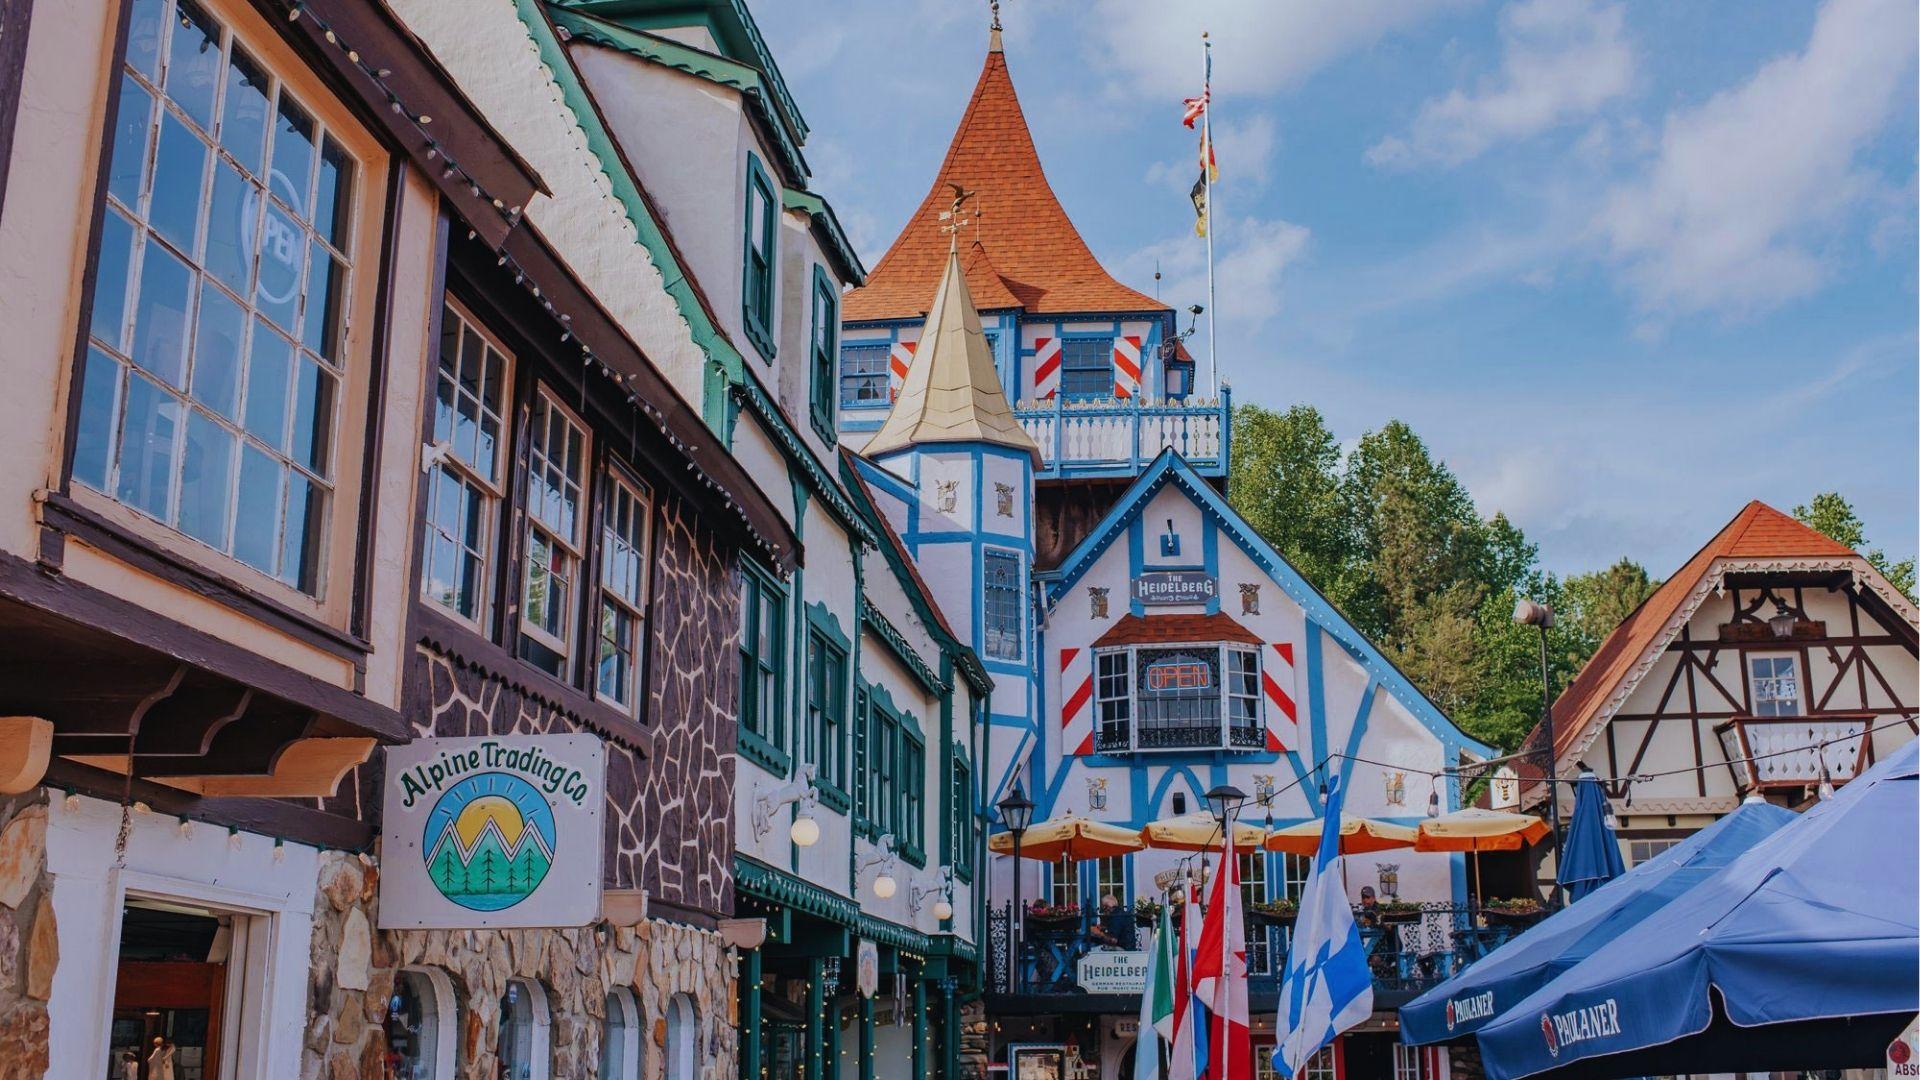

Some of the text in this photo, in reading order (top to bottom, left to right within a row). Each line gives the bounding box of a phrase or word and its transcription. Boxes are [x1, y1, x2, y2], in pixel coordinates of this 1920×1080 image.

[1138, 579, 1213, 597] HEIDELBERG
[1149, 664, 1207, 689] OPEN
[400, 742, 588, 808] Alpine Trading Co.
[1113, 955, 1129, 964] THE
[1083, 964, 1148, 981] HEIDELBER
[1453, 990, 1494, 1024] PAULANER
[1553, 998, 1621, 1047] PAULANER
